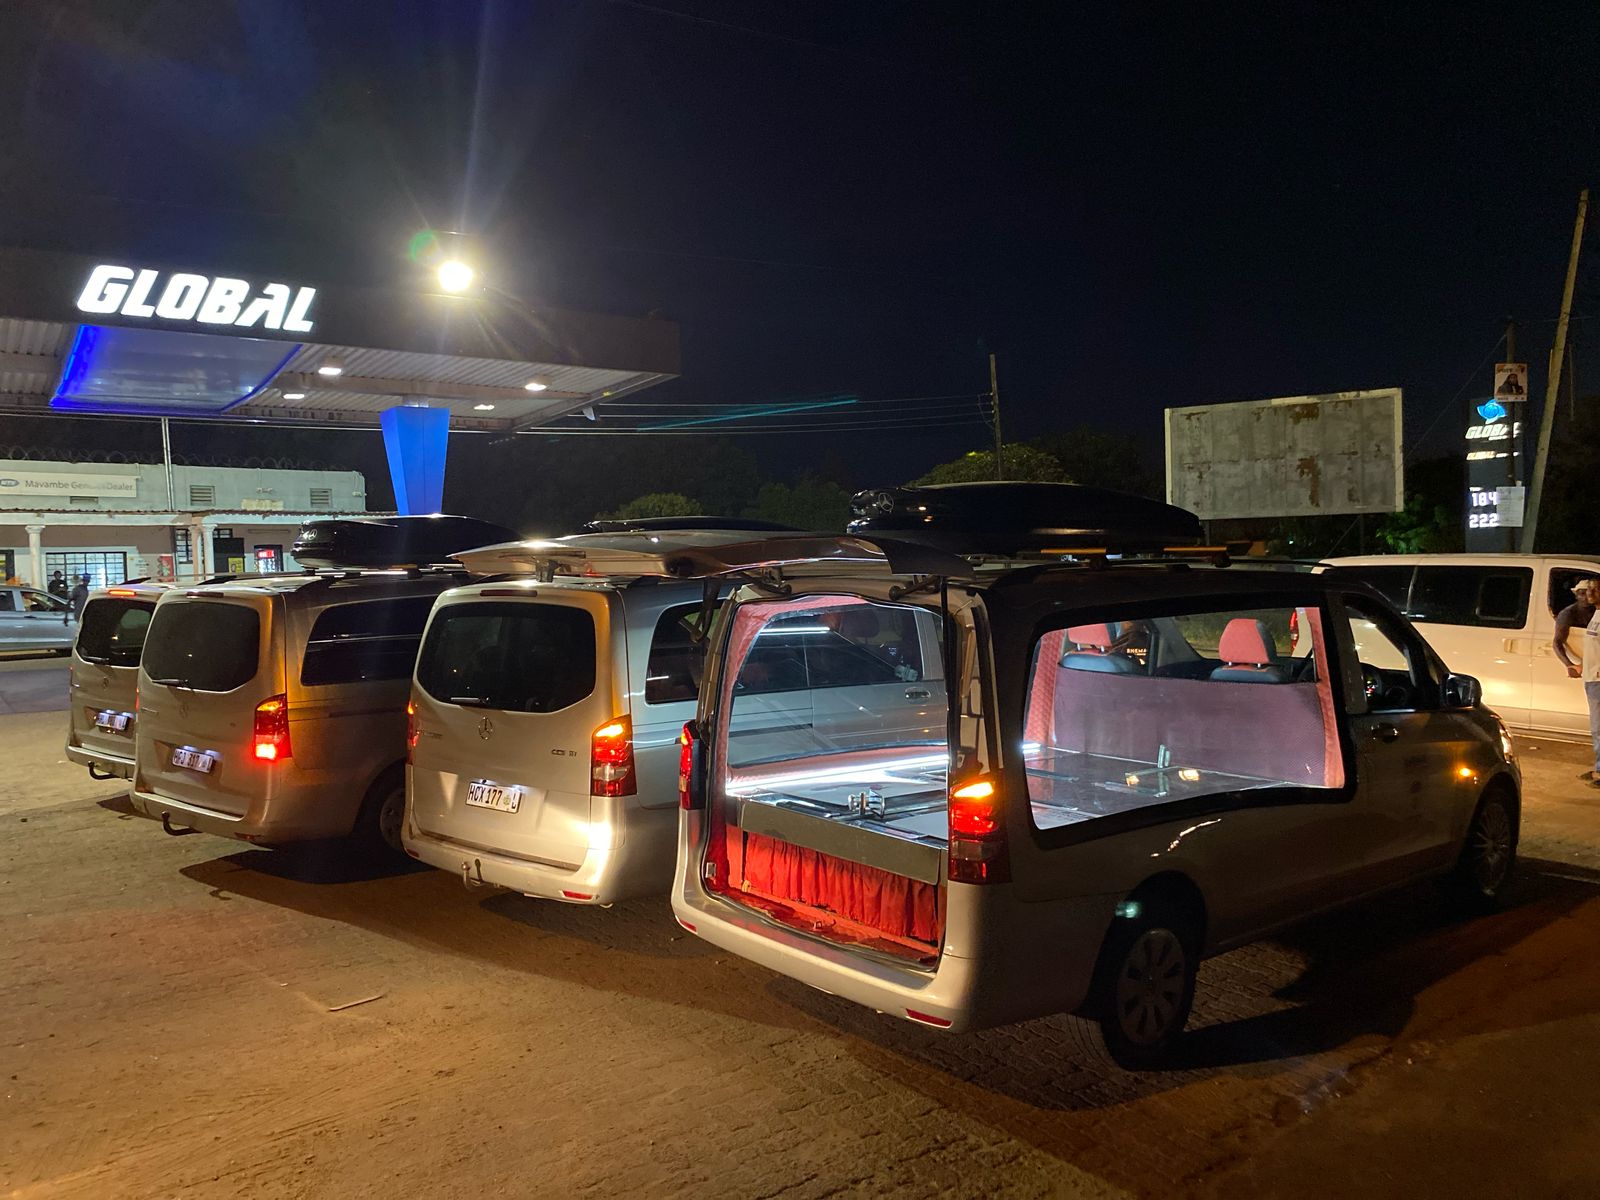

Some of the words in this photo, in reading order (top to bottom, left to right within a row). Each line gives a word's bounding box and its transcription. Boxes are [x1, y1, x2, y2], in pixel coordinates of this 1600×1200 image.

[76, 264, 317, 332] GLOBAL
[25, 480, 69, 489] Mavambe
[1469, 513, 1499, 528] 222
[468, 784, 486, 806] HCX
[487, 788, 503, 809] 177
